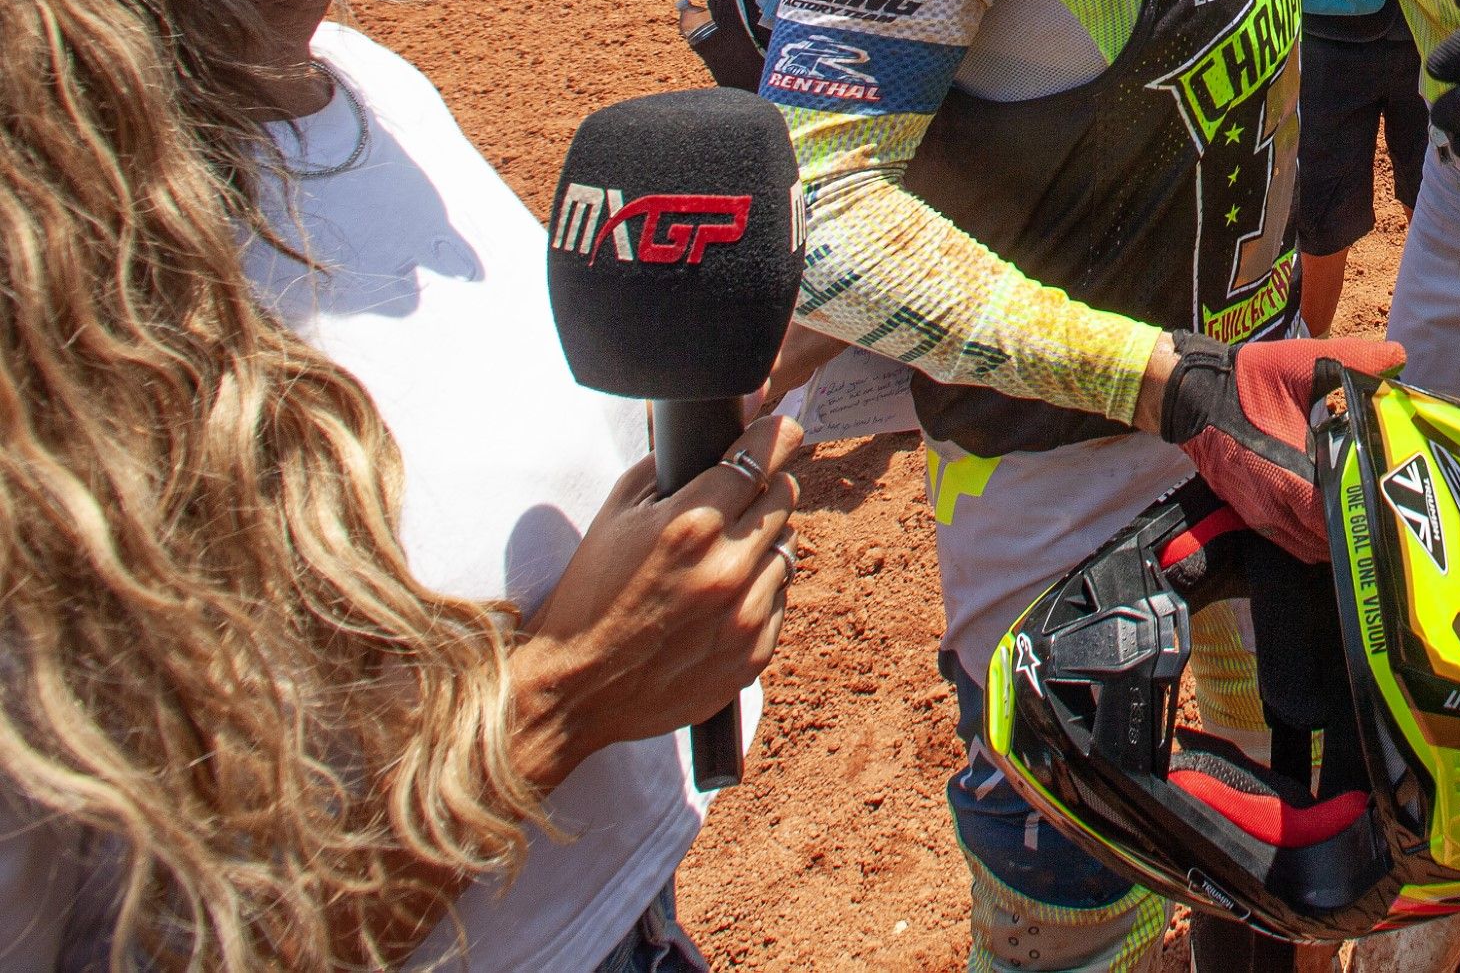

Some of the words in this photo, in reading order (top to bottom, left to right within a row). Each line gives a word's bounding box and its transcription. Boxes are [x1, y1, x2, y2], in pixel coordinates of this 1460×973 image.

[767, 71, 883, 103] RENTHAL
[552, 182, 752, 268] MXGP
[1346, 484, 1363, 512] ONE
[1423, 477, 1441, 541] TRIUMPH
[1350, 514, 1372, 554] GOAL
[1357, 556, 1377, 591] ONE
[1363, 594, 1388, 655] VISION
